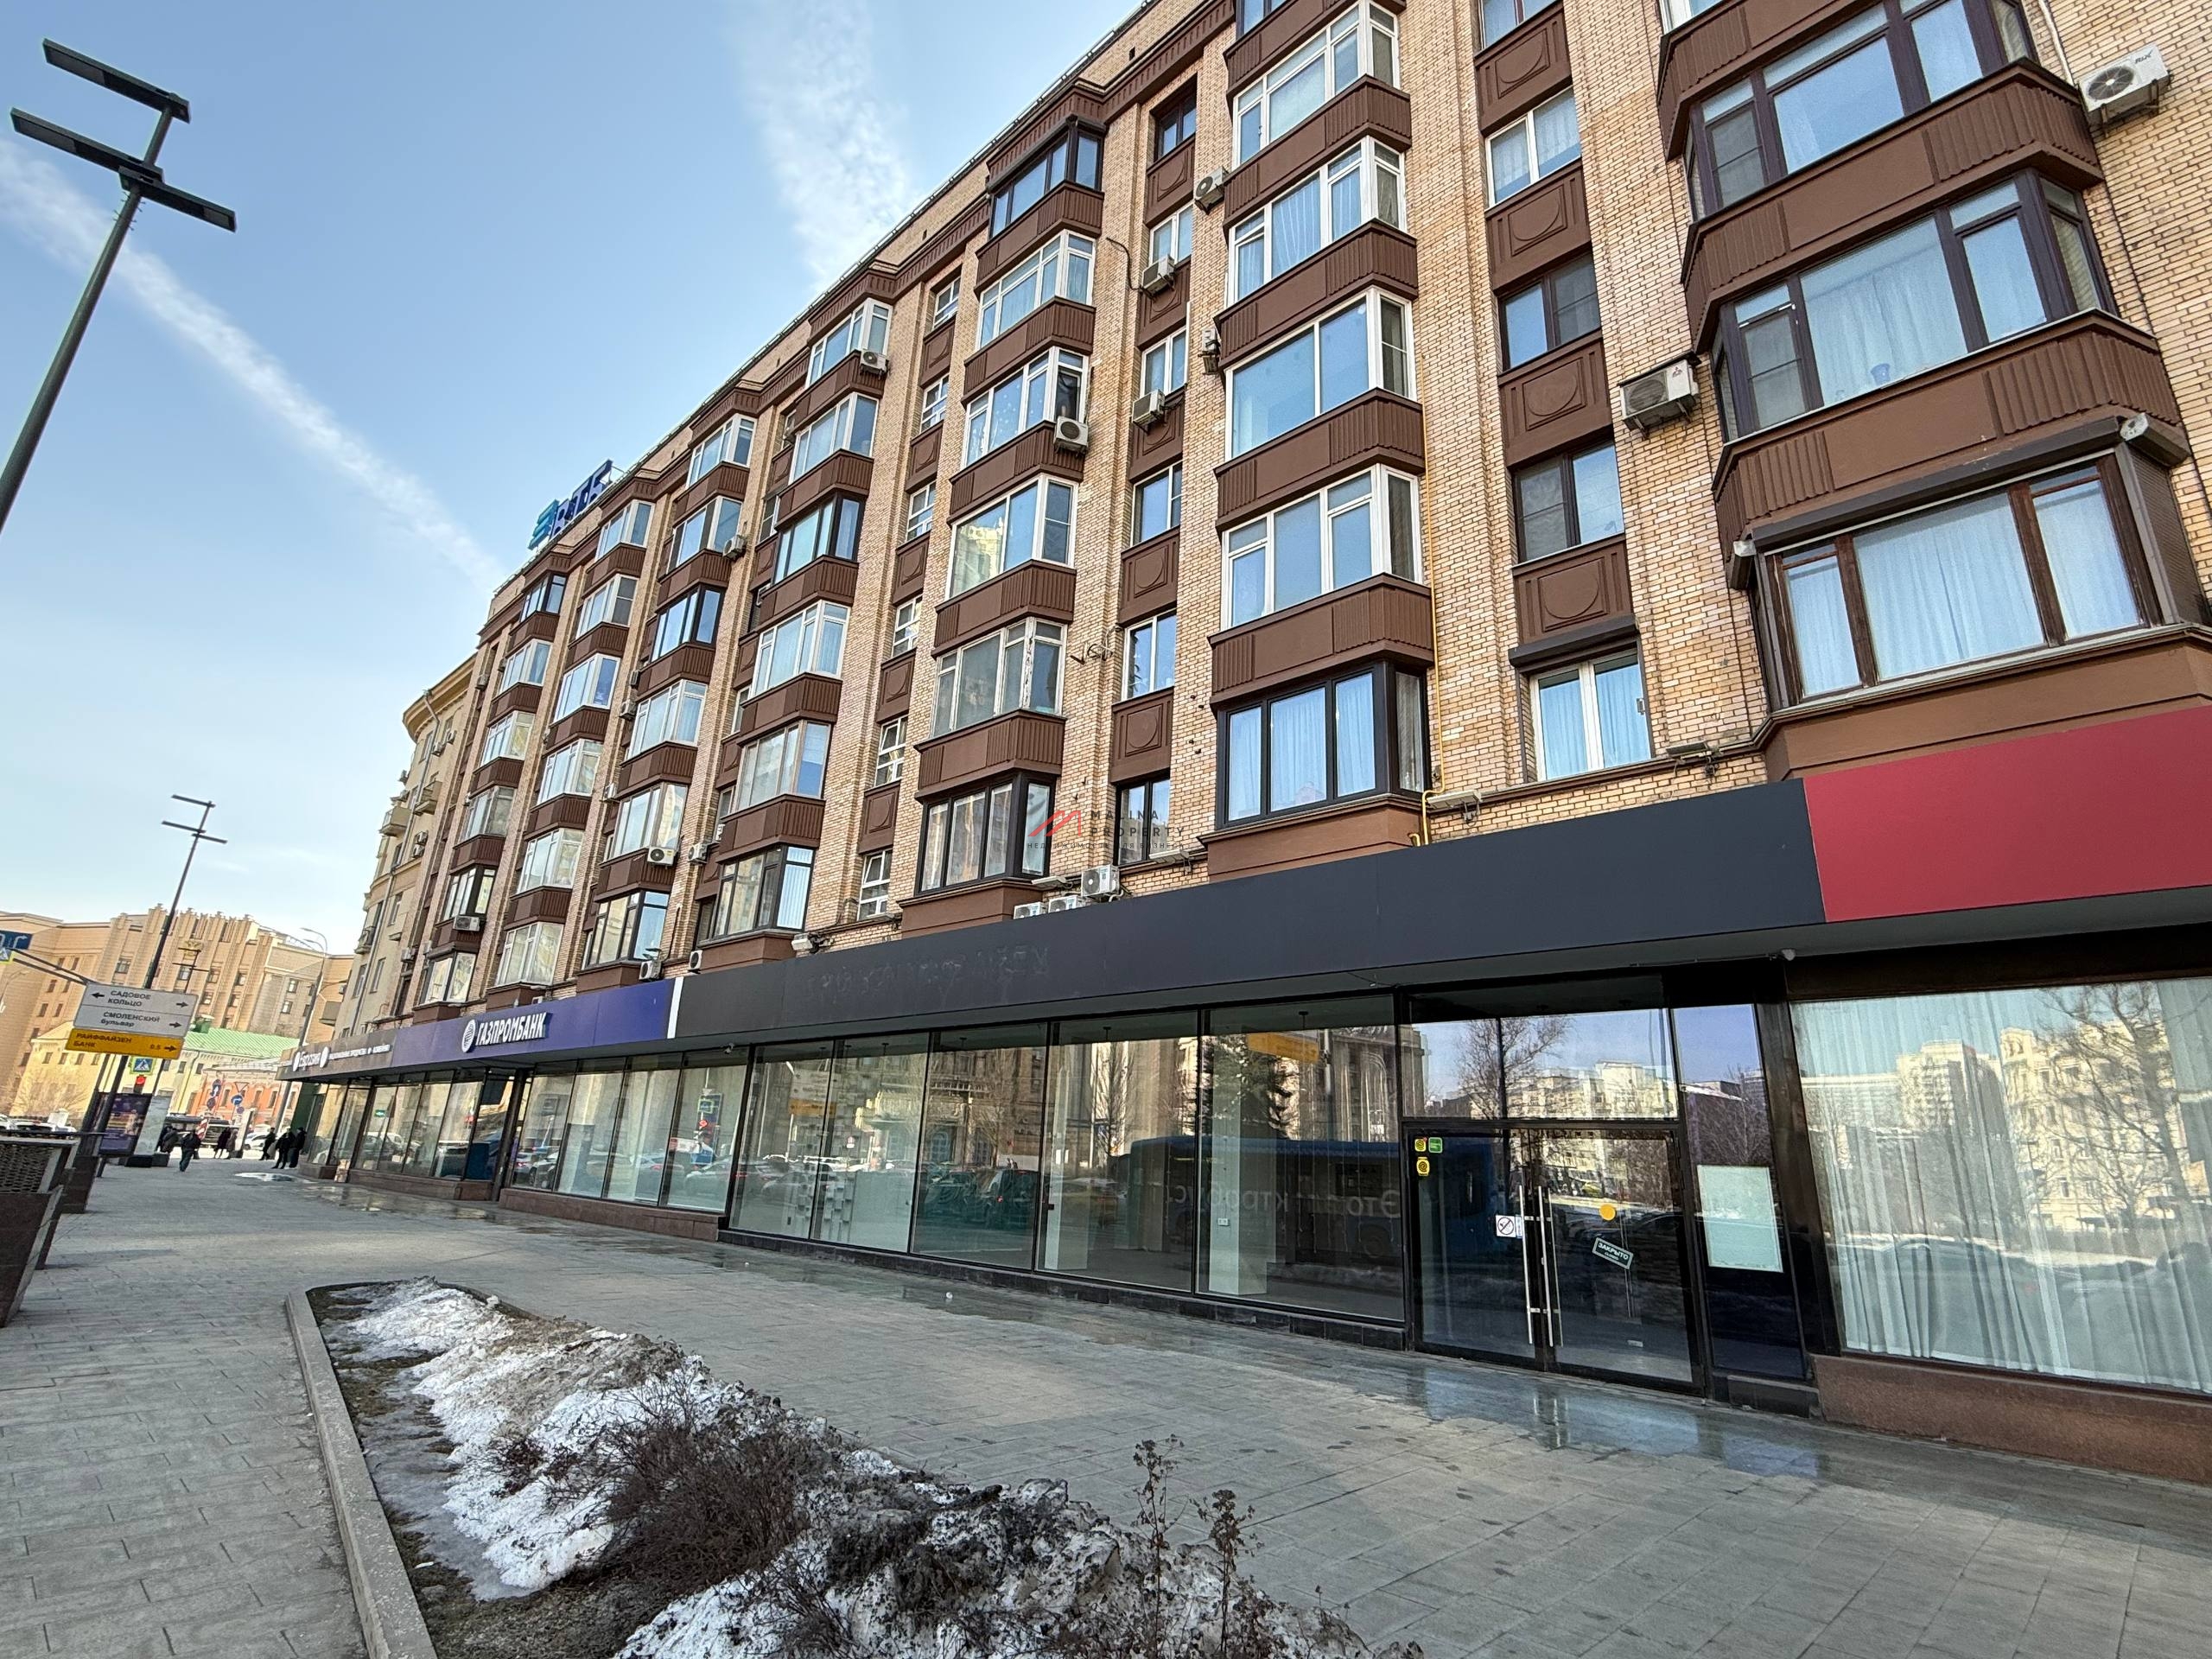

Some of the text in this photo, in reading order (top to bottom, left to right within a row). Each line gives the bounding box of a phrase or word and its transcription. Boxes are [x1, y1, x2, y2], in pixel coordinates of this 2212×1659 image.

[110, 990, 151, 1000] САДОВОЕ
[107, 998, 143, 1007] КОЛЬЦО
[103, 1011, 160, 1022] СМОЛЕНСКИЙ
[475, 1012, 547, 1046] ГАЗПРОМБАНК
[1599, 1243, 1628, 1260] ЗАКРЫТО
